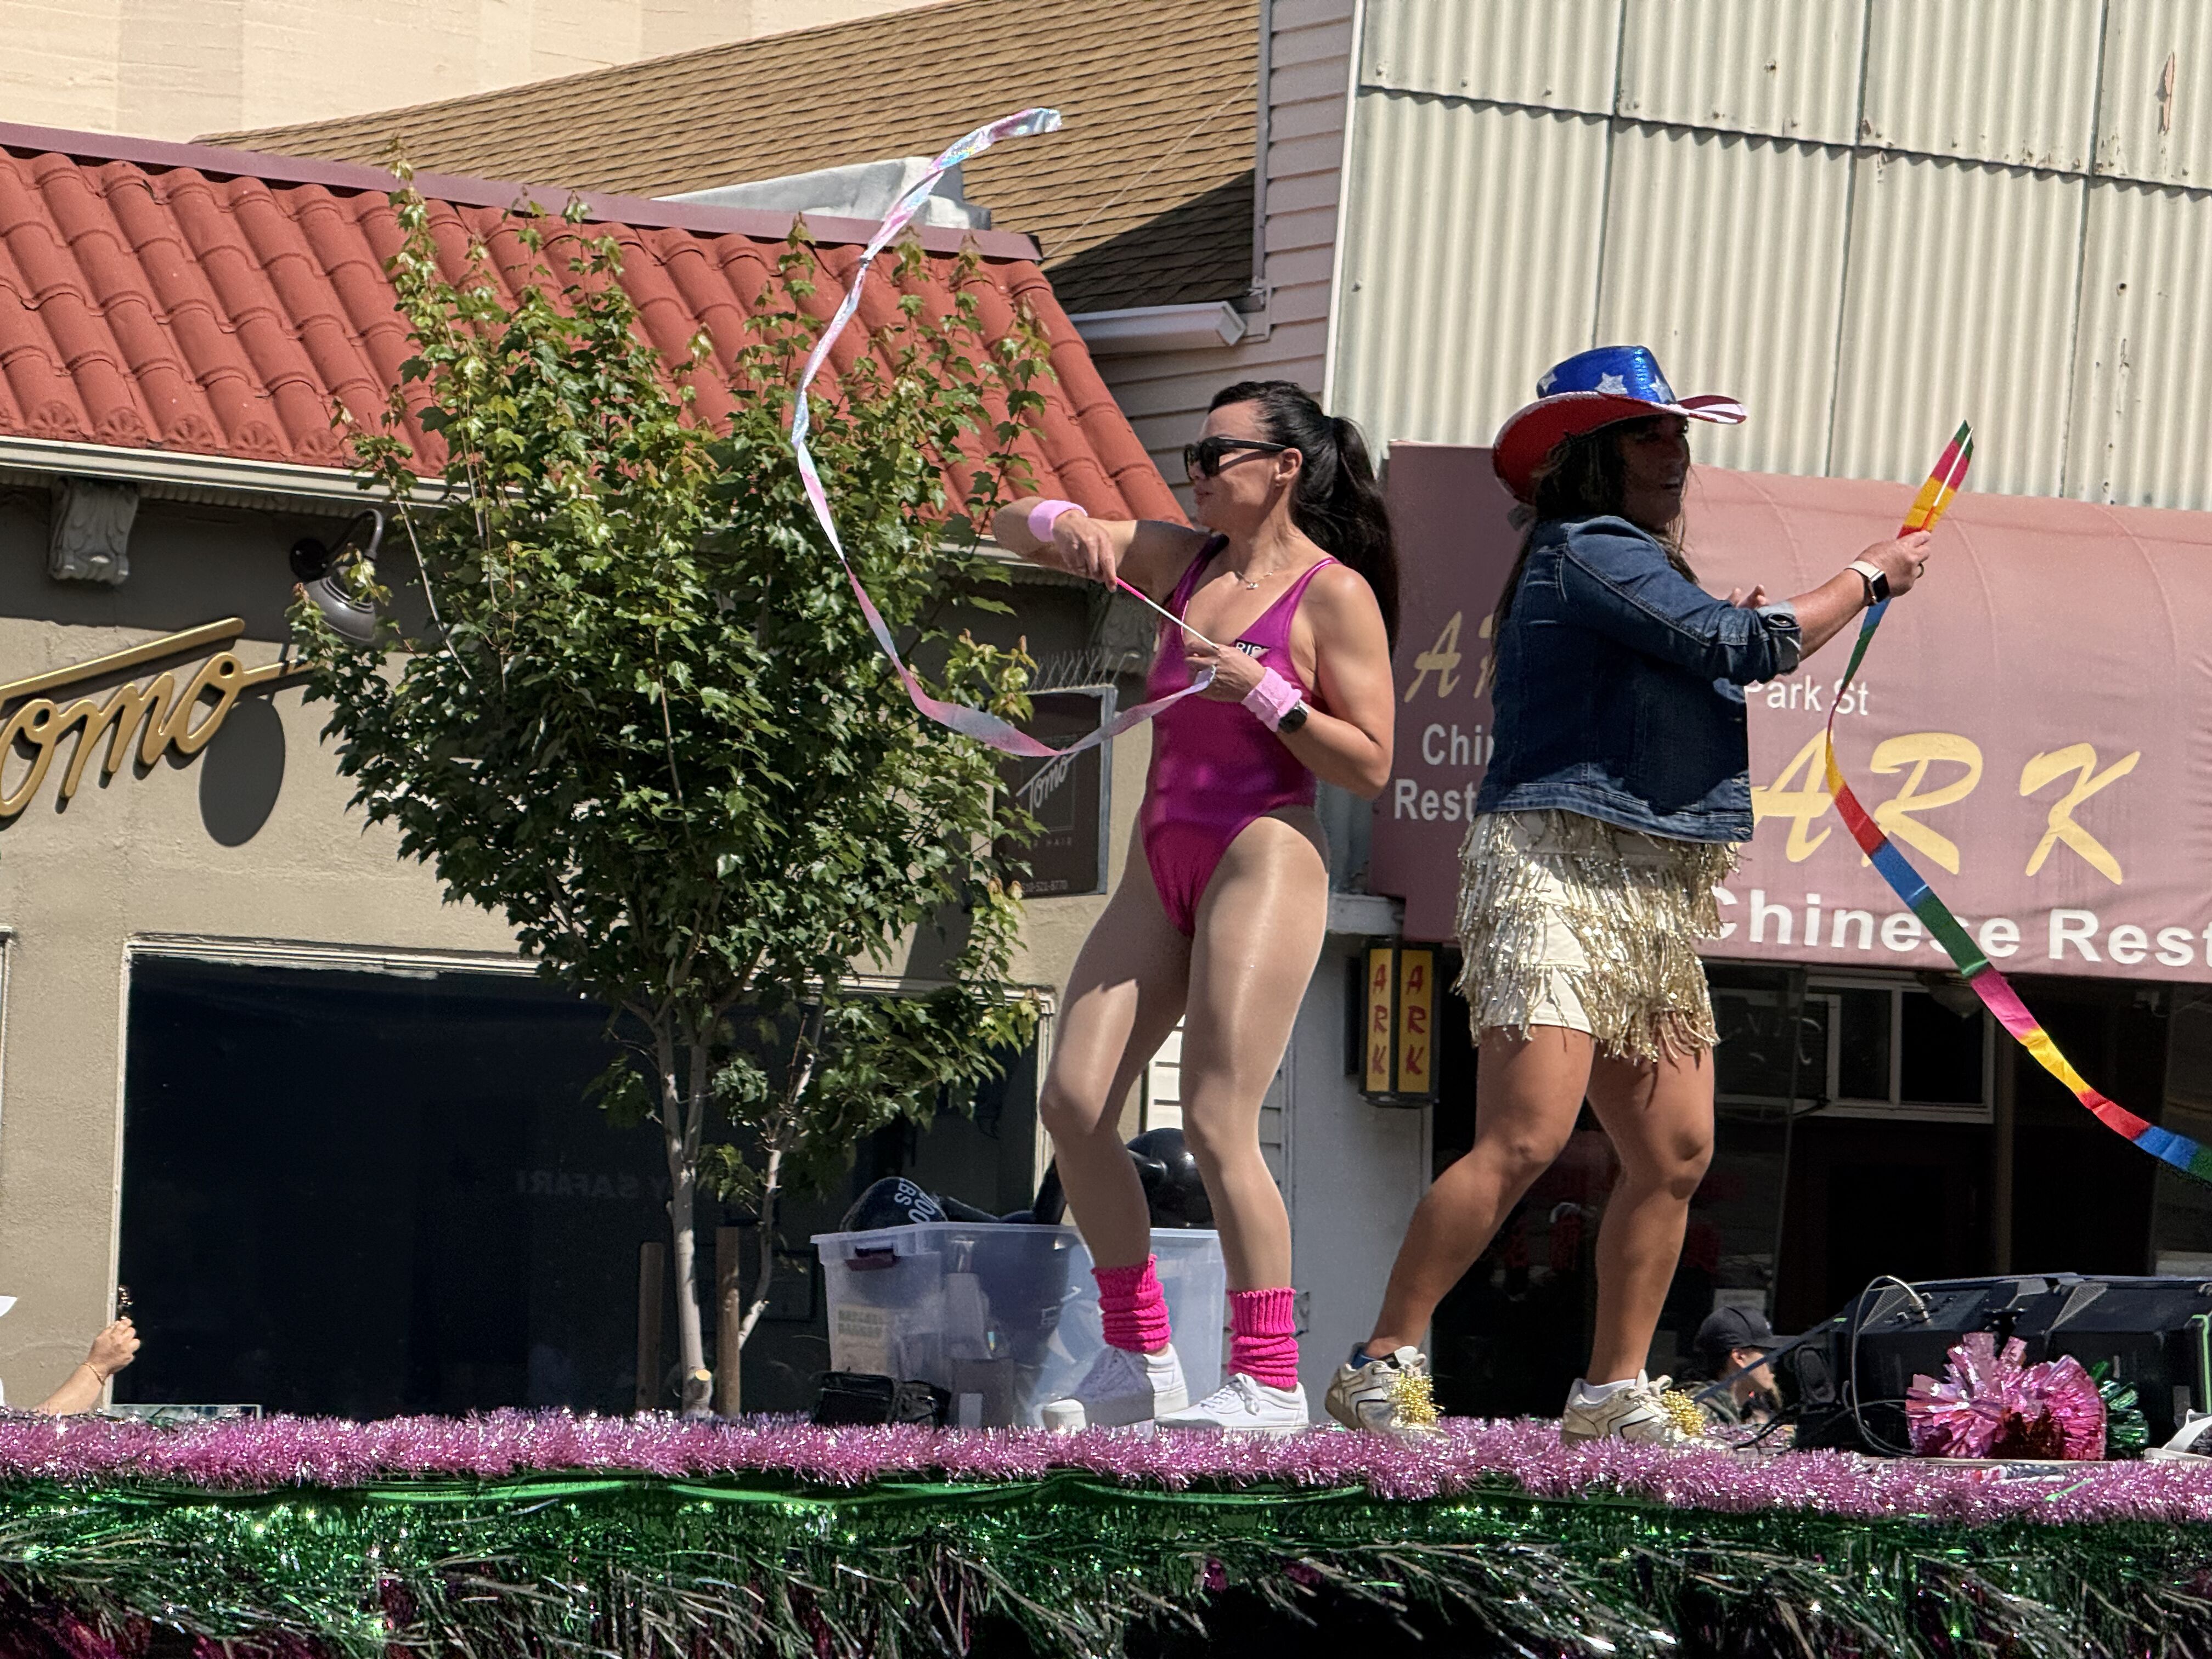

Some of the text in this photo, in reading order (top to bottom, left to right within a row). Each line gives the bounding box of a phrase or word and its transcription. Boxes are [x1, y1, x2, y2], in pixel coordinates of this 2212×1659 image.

[1832, 678, 1869, 716] St
[1015, 751, 1080, 817] Tomo
[1394, 778, 1477, 822] Rest
[1735, 728, 2141, 885] ARK
[1372, 964, 1389, 1075] ARK
[1406, 964, 1427, 1076] ARK
